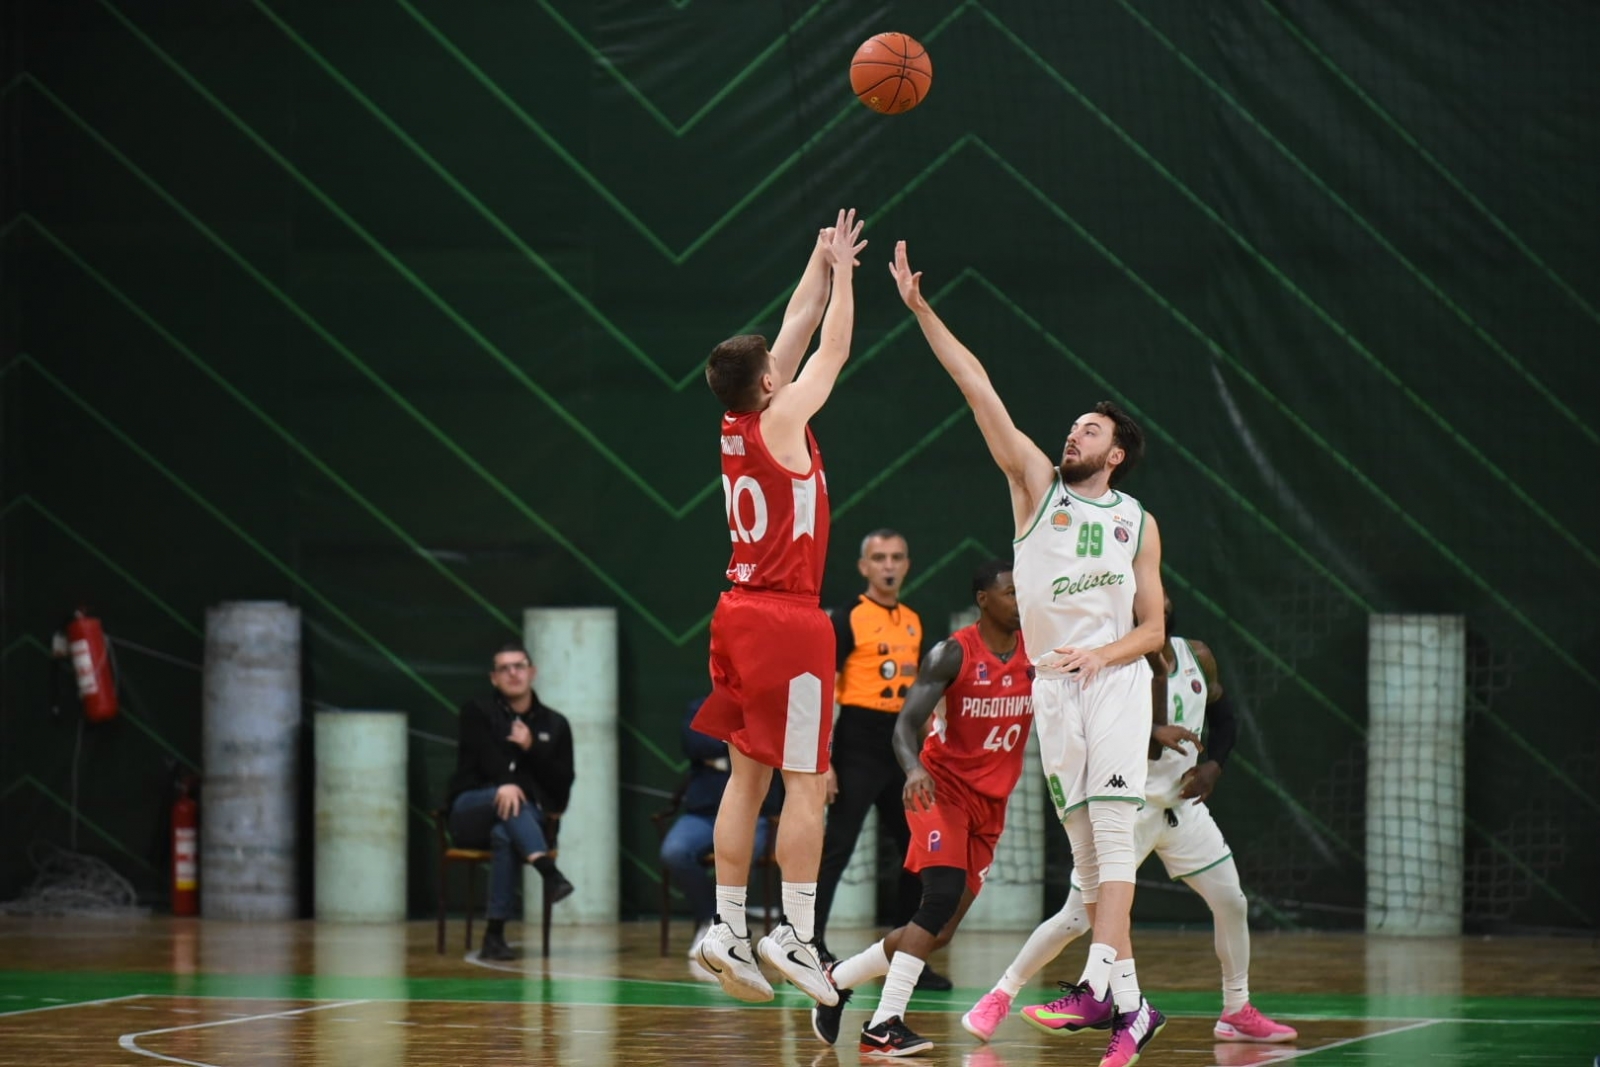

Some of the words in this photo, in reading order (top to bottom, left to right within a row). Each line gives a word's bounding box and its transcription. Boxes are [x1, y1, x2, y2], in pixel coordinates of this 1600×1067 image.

[1076, 521, 1104, 558] 99
[1052, 570, 1125, 602] Pelister
[983, 724, 1022, 752] 40
